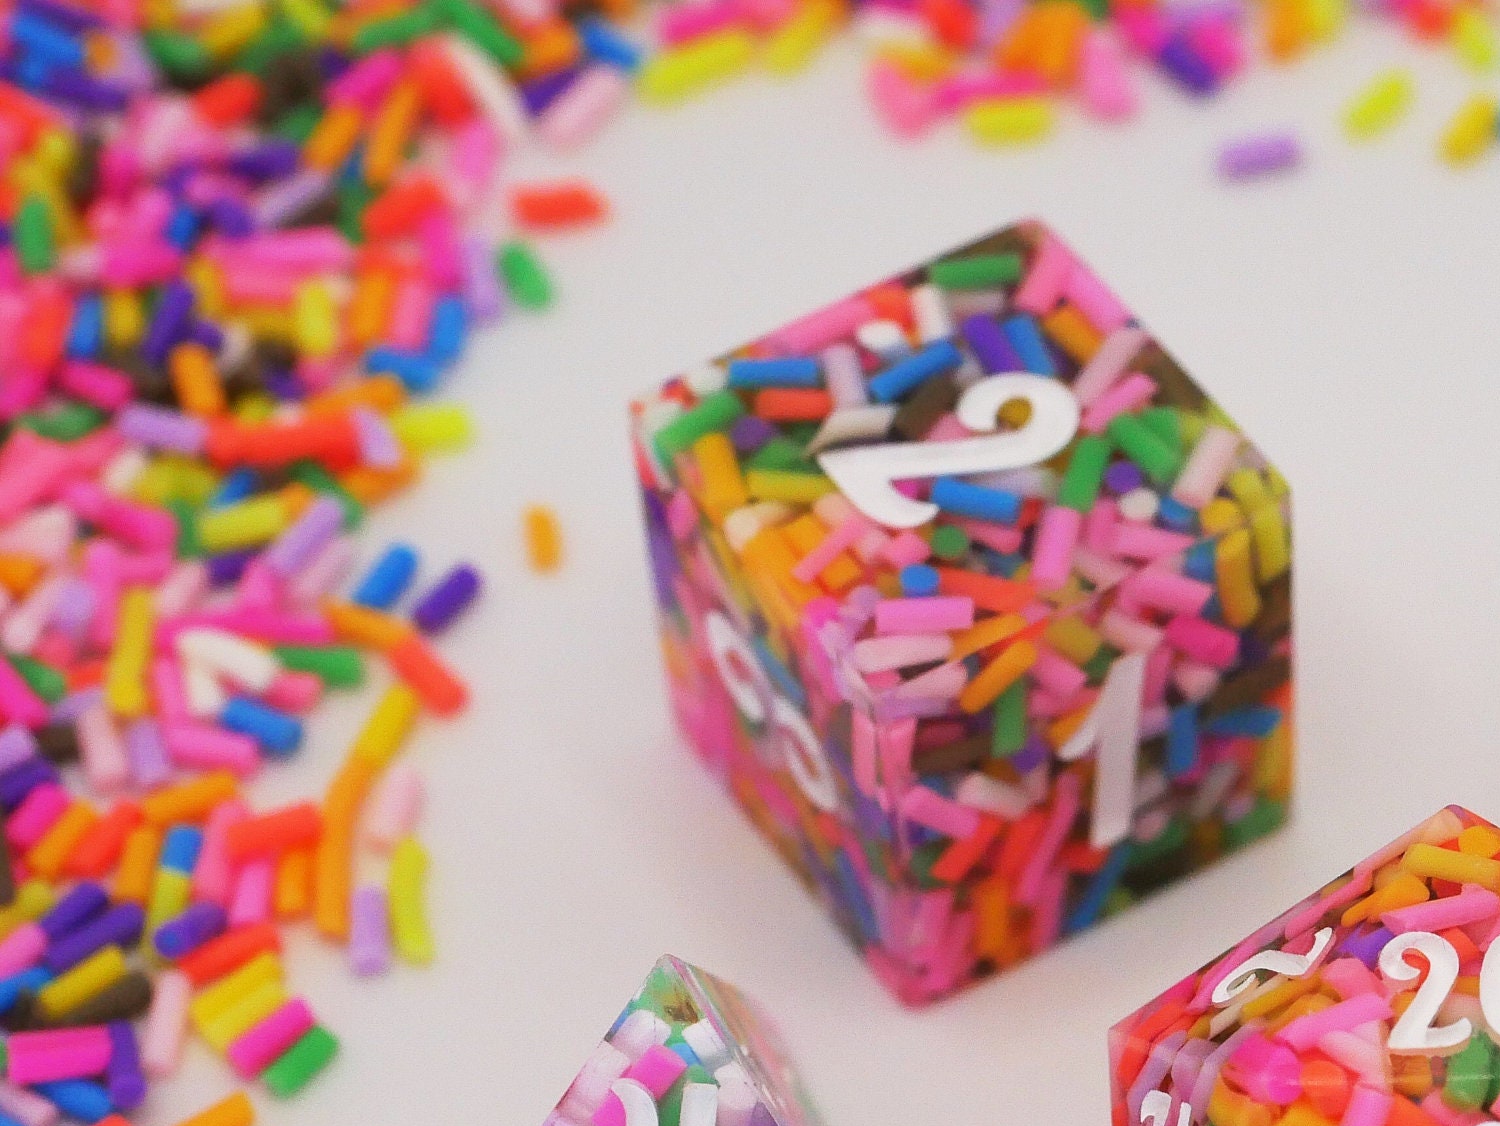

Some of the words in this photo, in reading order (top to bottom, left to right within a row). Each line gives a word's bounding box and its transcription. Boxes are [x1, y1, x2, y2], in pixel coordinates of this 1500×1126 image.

[817, 372, 1080, 528] 2
[1058, 651, 1147, 848] 1
[1211, 927, 1333, 1005] 2
